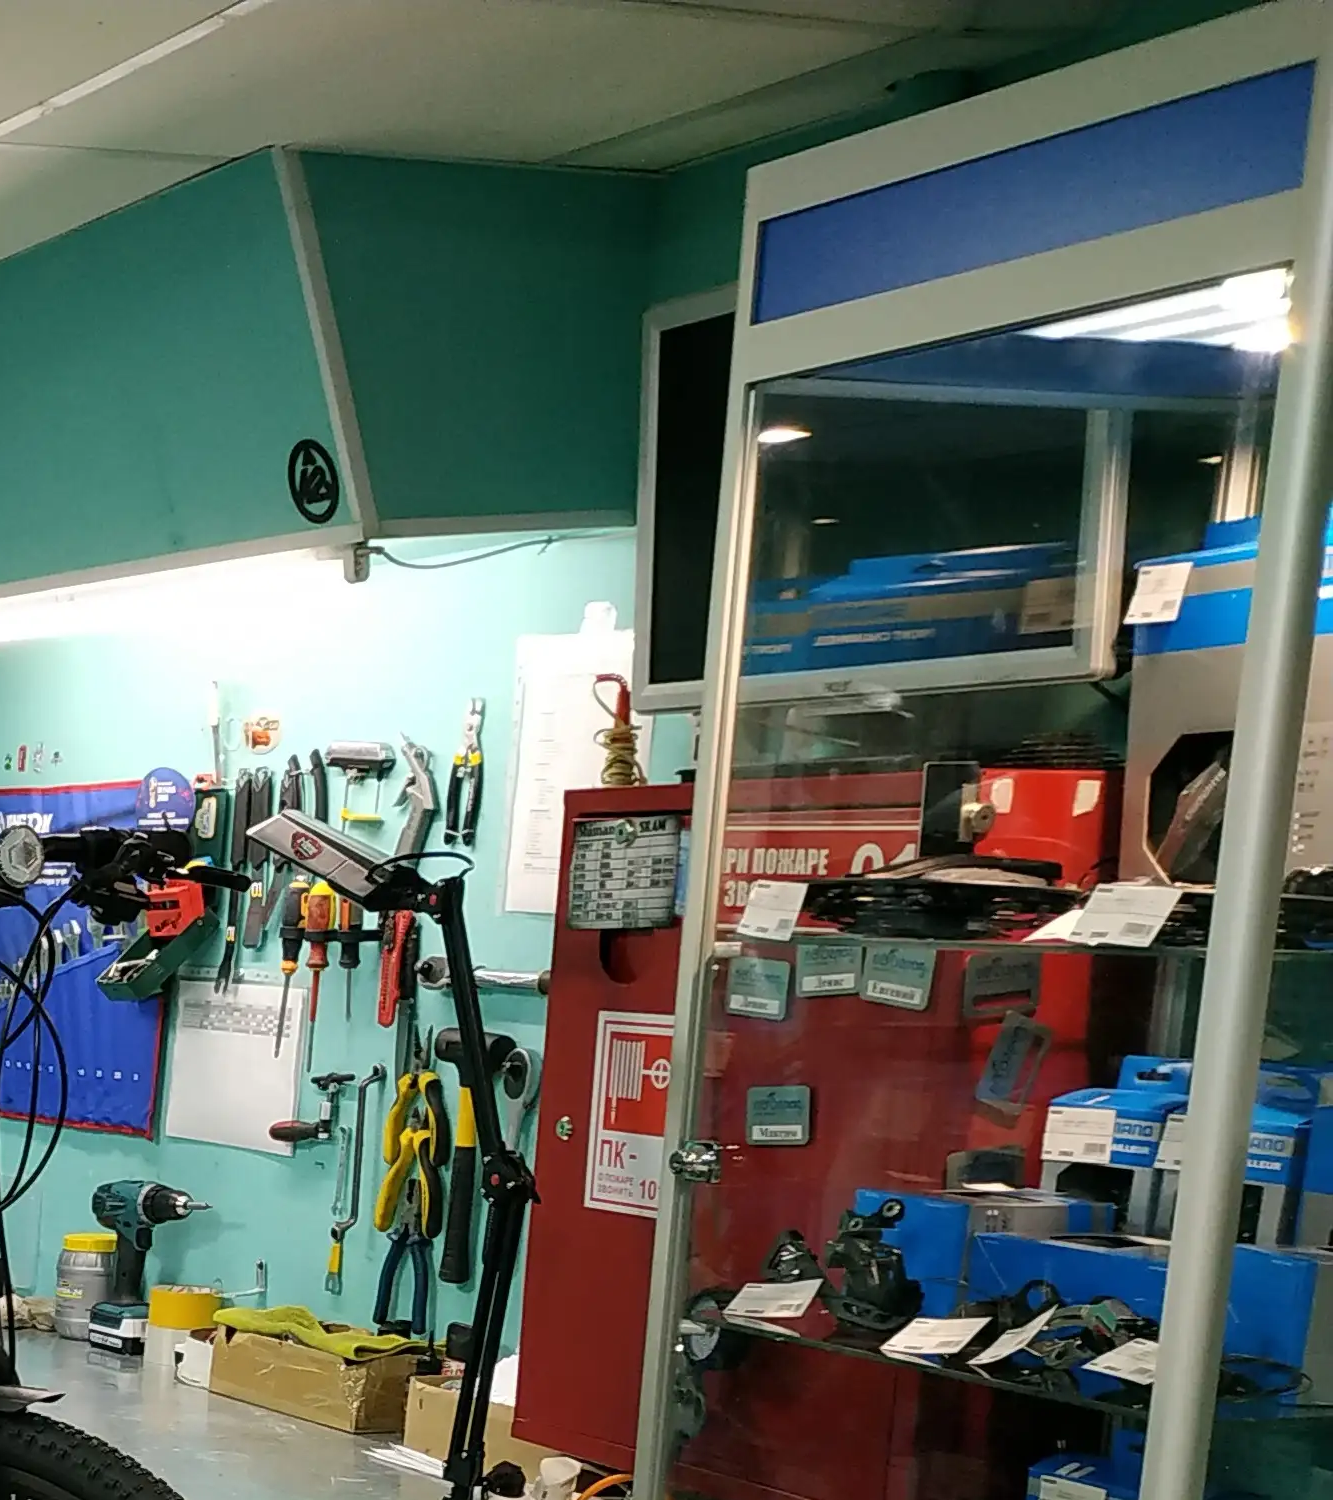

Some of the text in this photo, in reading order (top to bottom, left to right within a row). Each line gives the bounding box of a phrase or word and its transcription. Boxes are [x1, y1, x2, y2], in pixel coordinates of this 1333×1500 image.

[752, 848, 830, 876] ПОЖАРЕ
[599, 1139, 637, 1170] ПК-
[639, 1179, 659, 1201] 10
